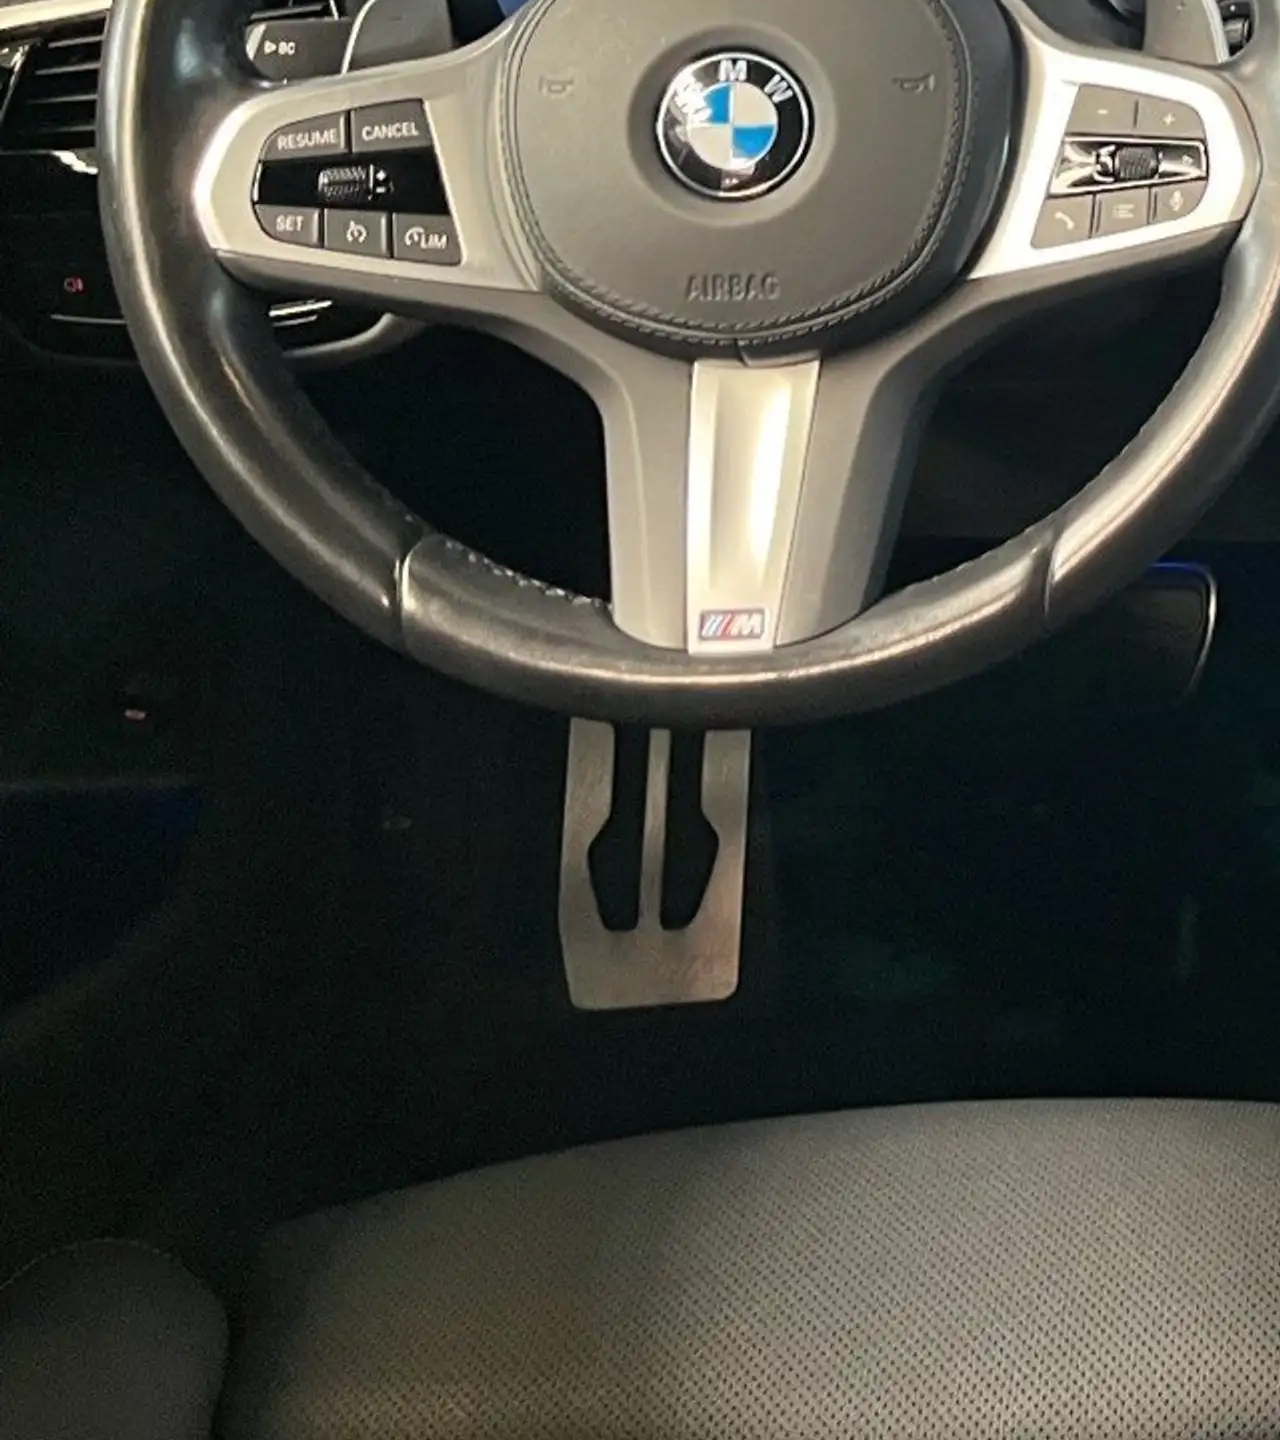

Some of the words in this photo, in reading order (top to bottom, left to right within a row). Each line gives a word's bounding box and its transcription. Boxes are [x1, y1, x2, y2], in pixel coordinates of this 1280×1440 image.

[278, 41, 296, 56] BC
[277, 128, 338, 151] RESUME
[361, 121, 420, 142] CANCEL
[275, 215, 304, 232] SET
[419, 233, 448, 251] LIM
[684, 273, 781, 301] AIRBAG
